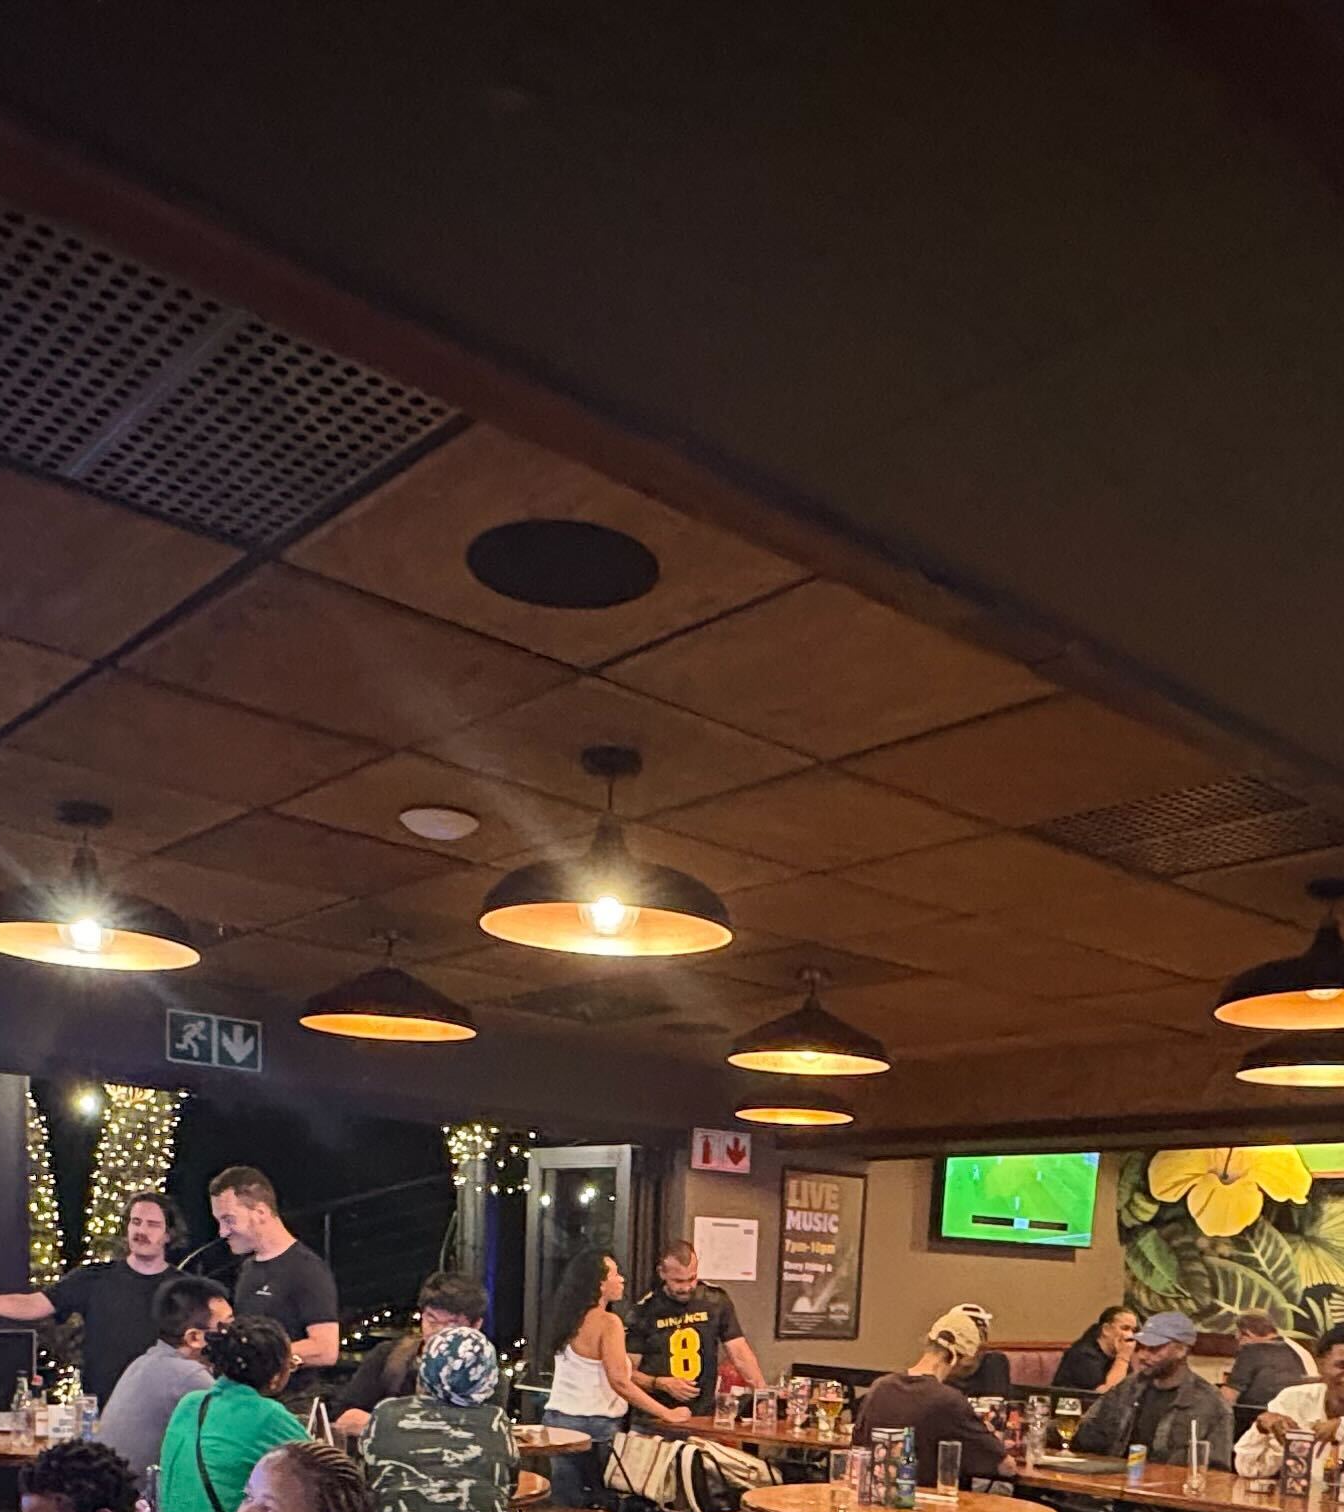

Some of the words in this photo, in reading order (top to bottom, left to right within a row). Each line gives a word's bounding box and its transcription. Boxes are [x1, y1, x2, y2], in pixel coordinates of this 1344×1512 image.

[787, 1179, 840, 1212] LIVE
[785, 1208, 840, 1234] MUSIC
[670, 1327, 702, 1382] 8
